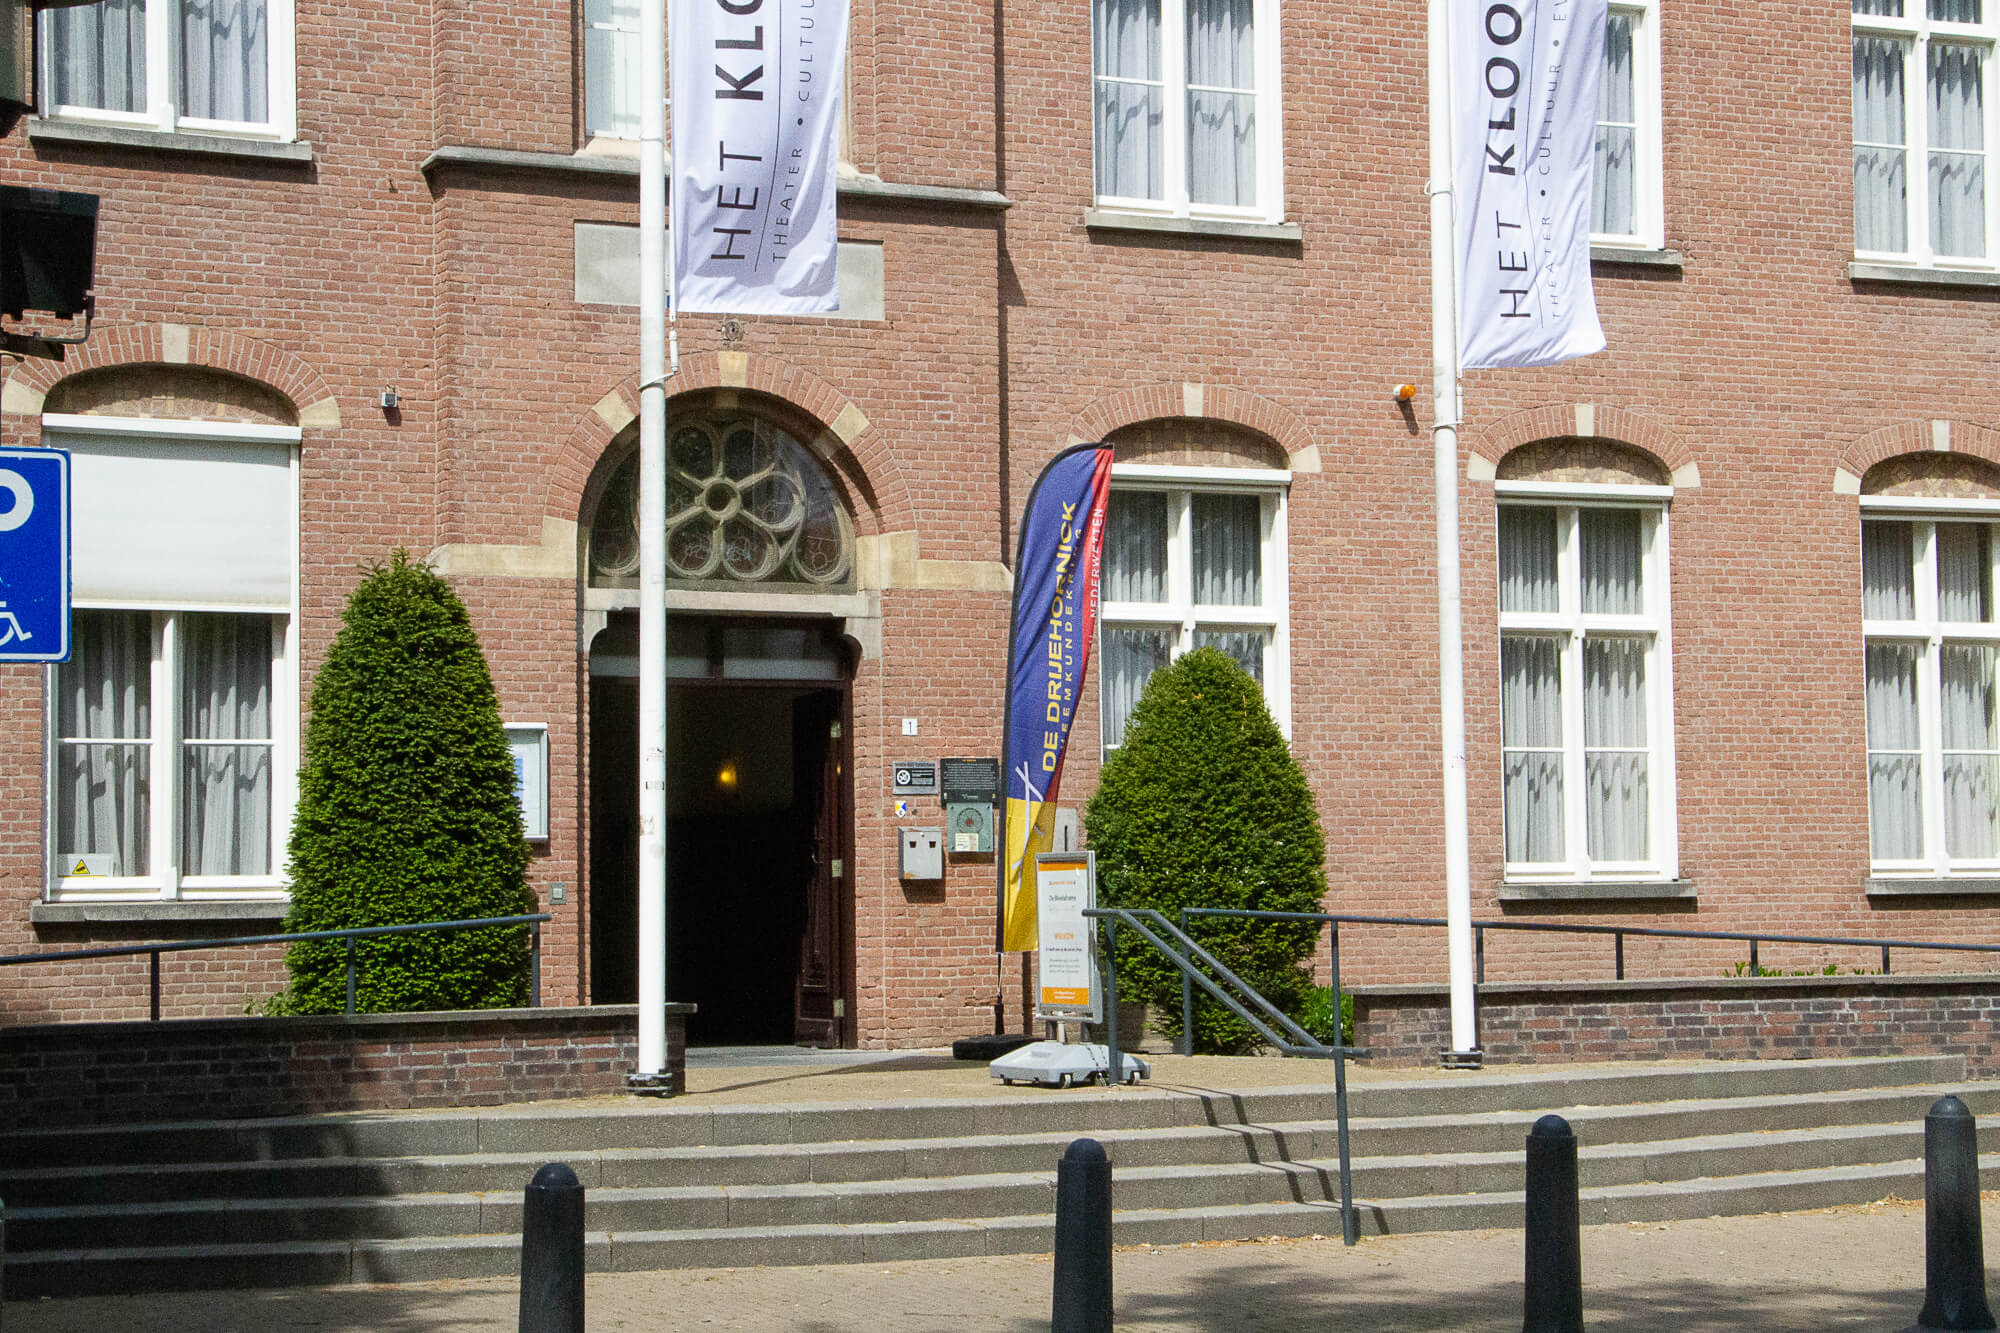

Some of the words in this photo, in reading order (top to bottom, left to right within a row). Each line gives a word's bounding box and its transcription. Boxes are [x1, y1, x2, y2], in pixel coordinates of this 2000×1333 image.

[1485, 3, 1522, 177] KLOO
[1538, 65, 1562, 176] CULTUUR
[711, 140, 762, 260] HET
[772, 148, 803, 262] THEATER
[1496, 210, 1531, 318] HET
[1541, 215, 1561, 319] THEATER
[1046, 501, 1076, 723] DRIJEHORNICK
[1088, 508, 1105, 619] NEDERWETTEN
[1042, 731, 1059, 772] DE
